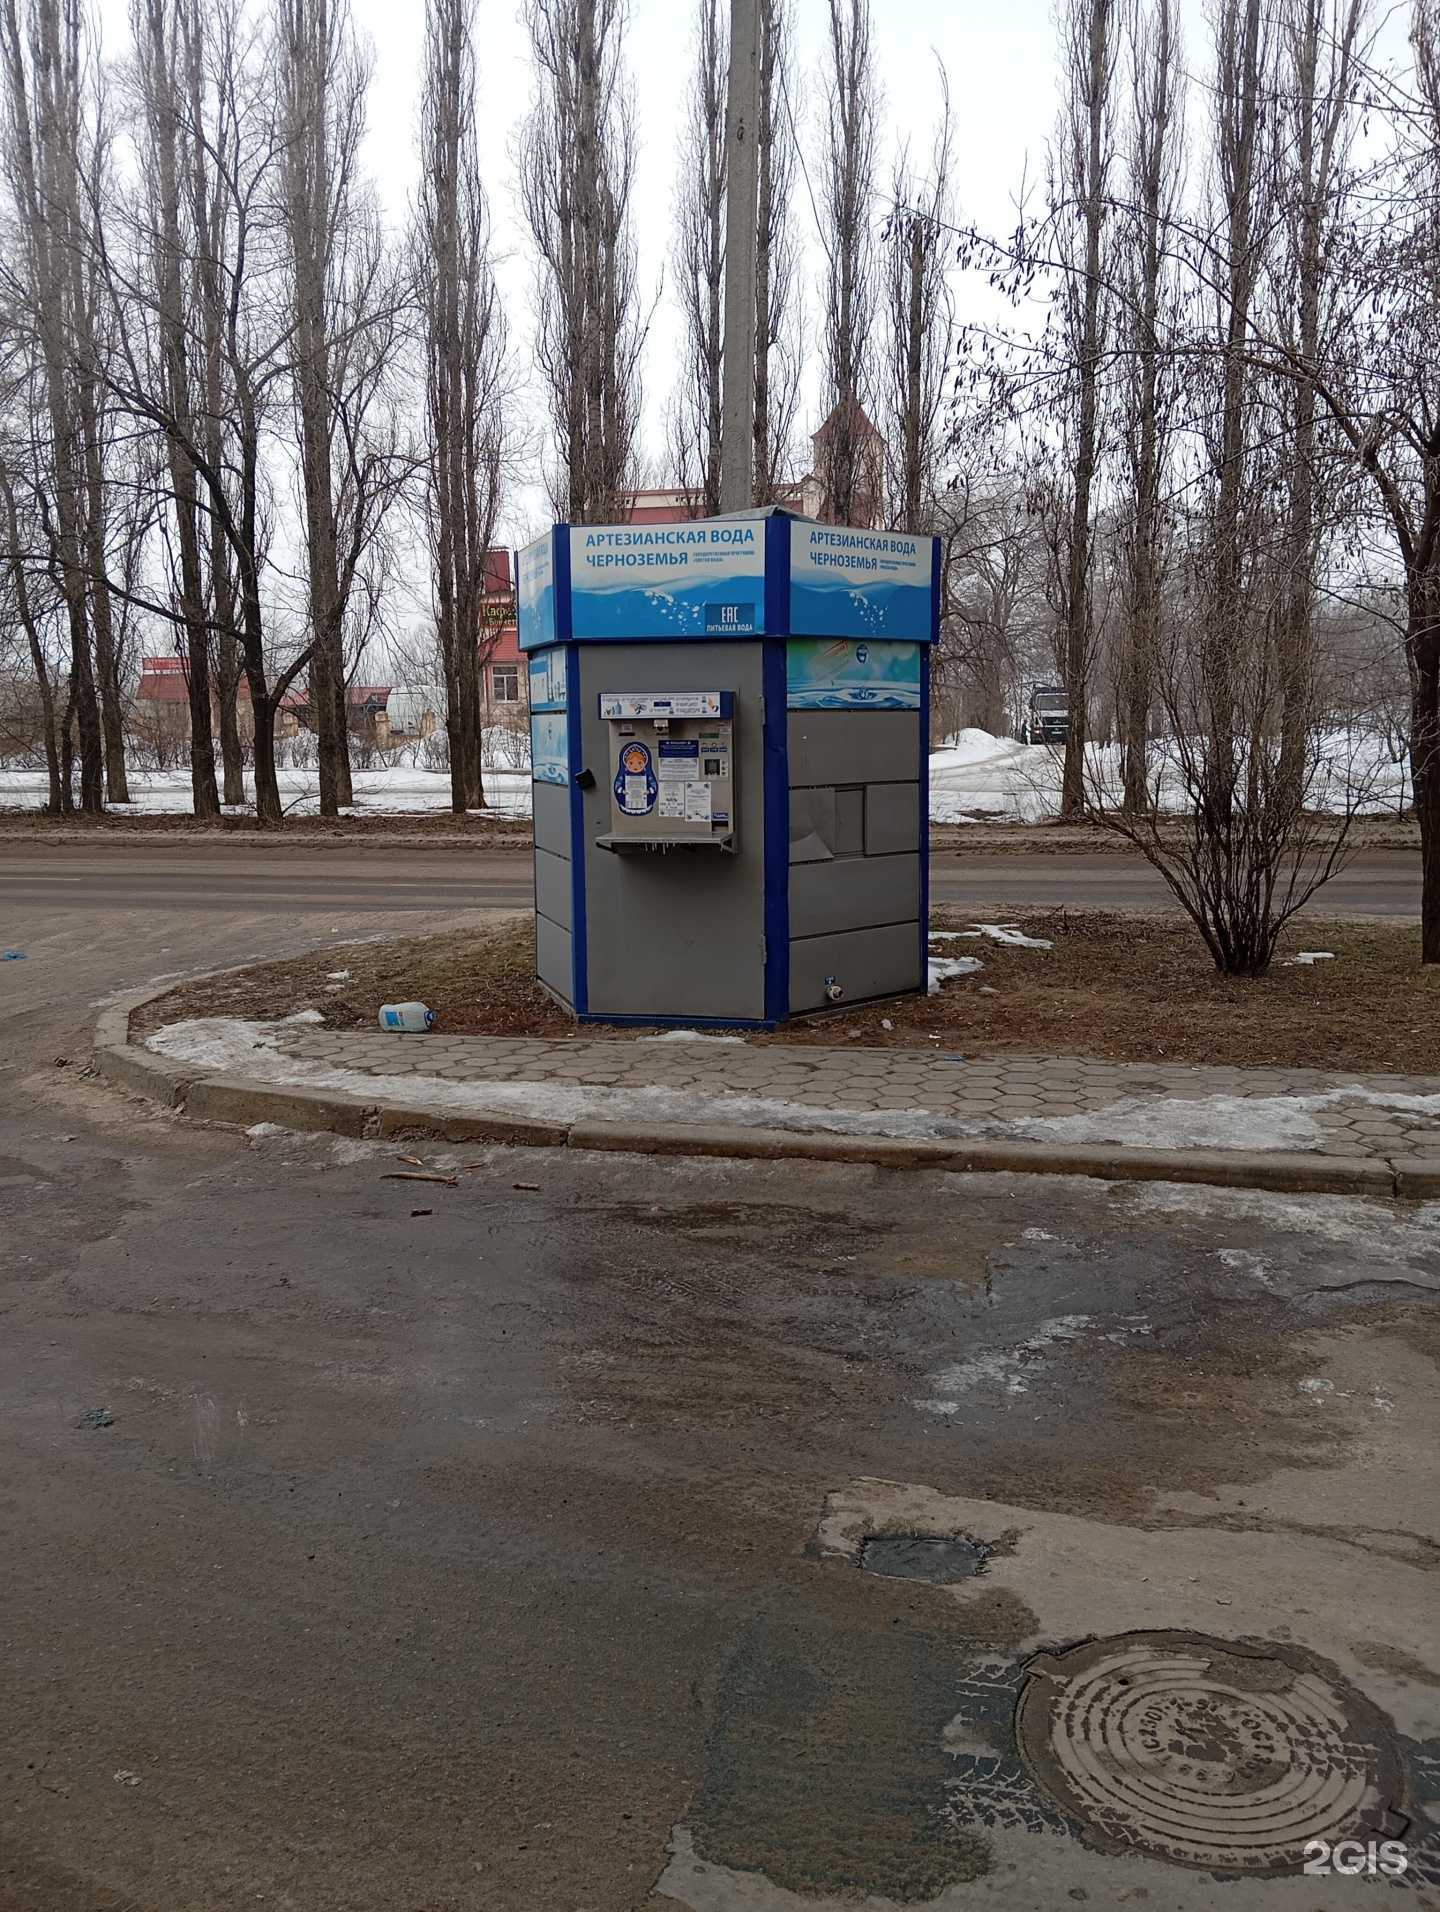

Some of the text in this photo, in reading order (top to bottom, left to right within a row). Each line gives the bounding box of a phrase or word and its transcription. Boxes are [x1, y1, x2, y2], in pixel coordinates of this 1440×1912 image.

[586, 529, 754, 547] АРТЕЗИАНСКАЯ ВОДА
[809, 531, 916, 556] АРТЕЗИАНСКАЯ ВОДА
[586, 552, 688, 567] ЧЕРНОЗЕМЬЯ
[809, 552, 877, 570] ЧЕРНОЗЕМЬЯ
[706, 623, 753, 632] ПИТЬЕВАЯ ВОДА
